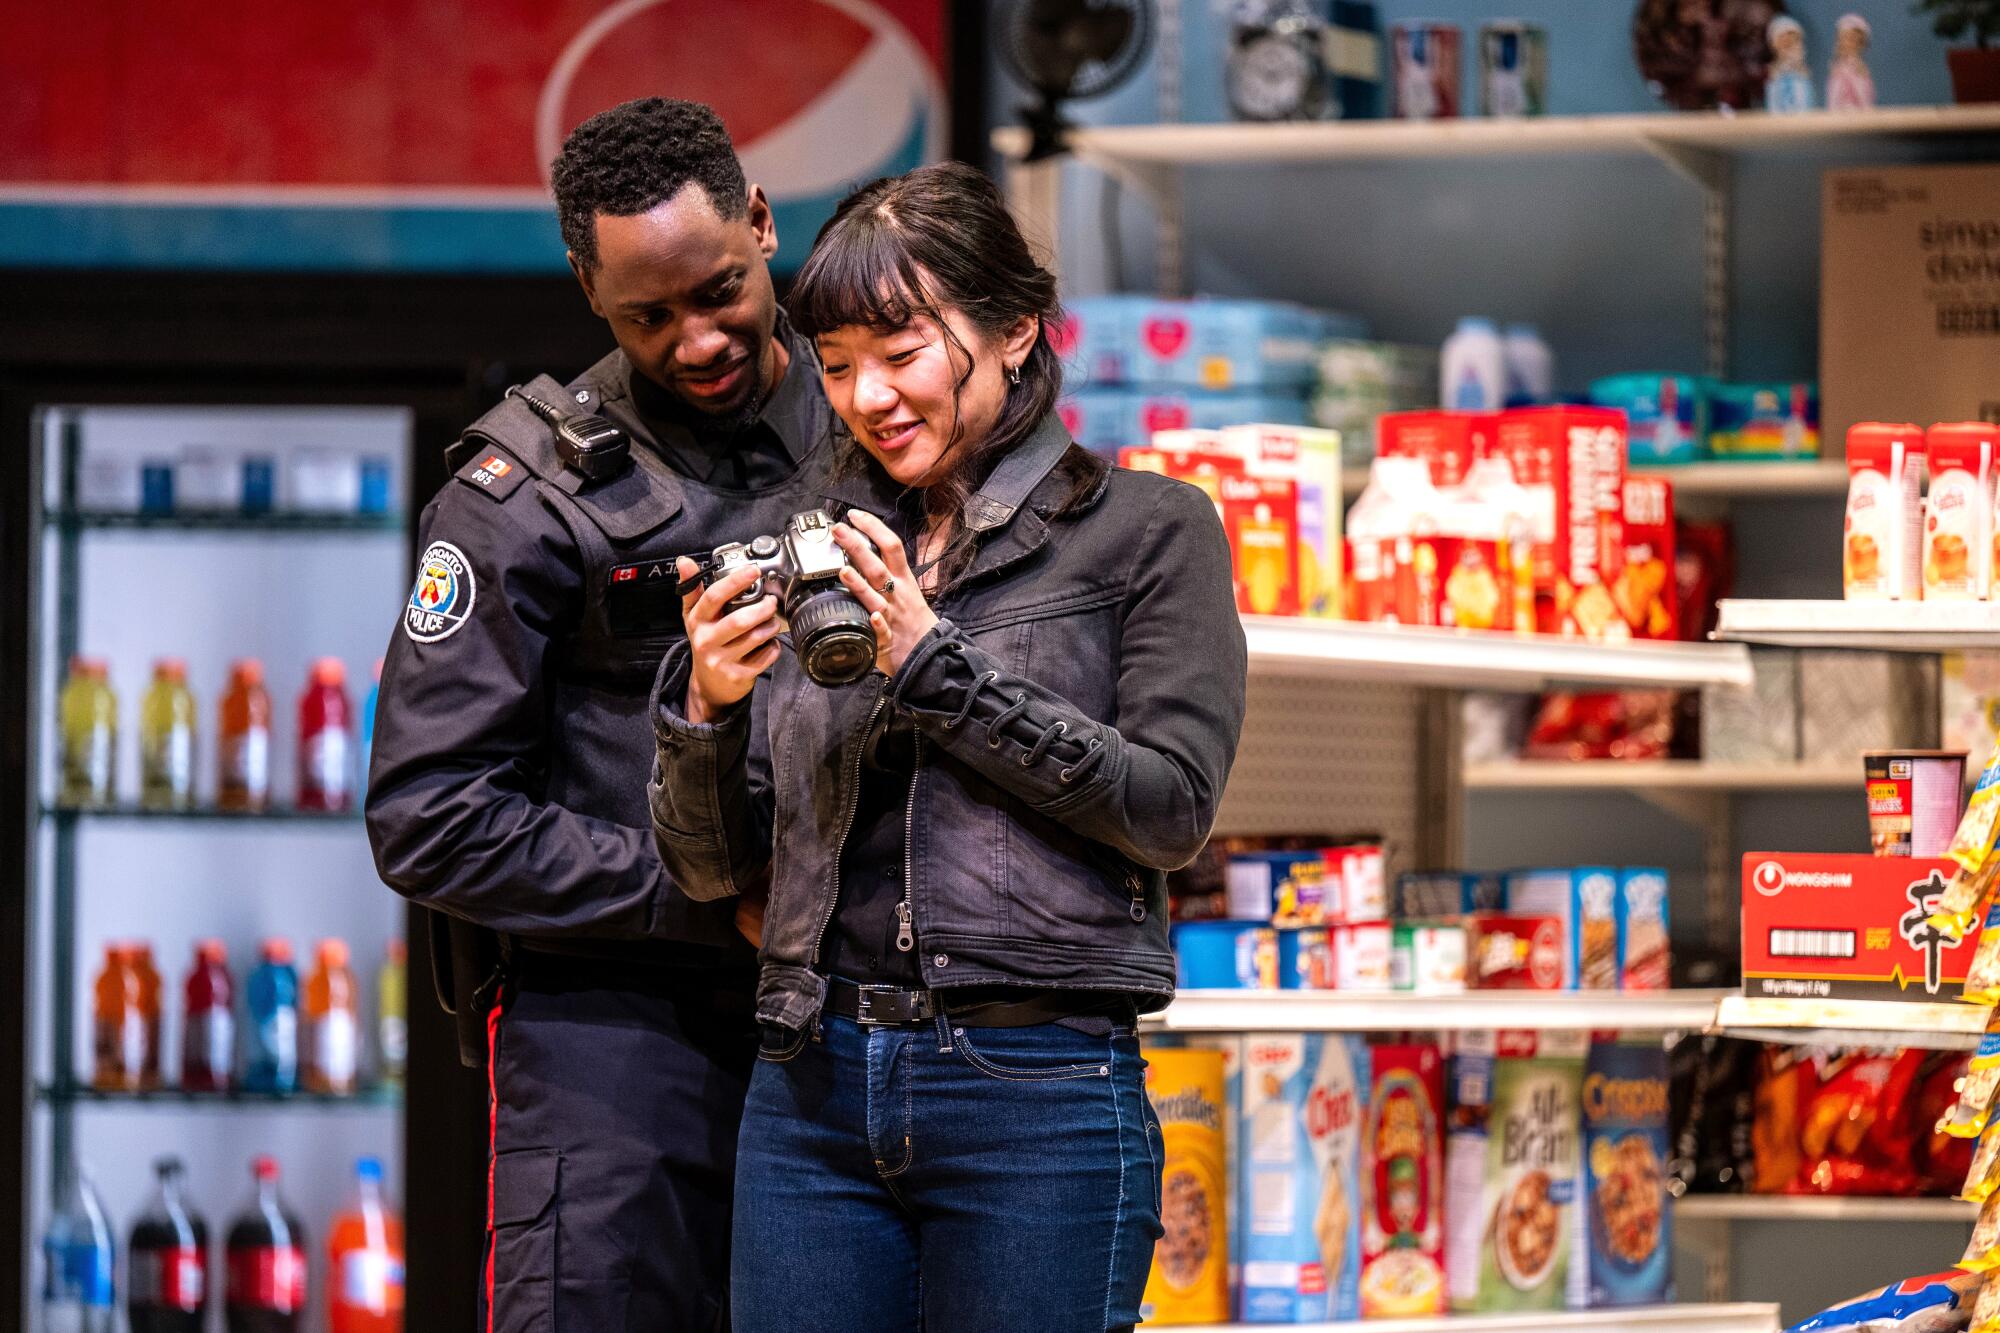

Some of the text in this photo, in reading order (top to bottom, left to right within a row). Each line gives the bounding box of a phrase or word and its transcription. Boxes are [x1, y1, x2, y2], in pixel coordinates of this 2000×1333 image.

[471, 469, 495, 486] 065
[422, 548, 464, 576] TORONTO
[811, 568, 838, 580] Canon
[409, 609, 444, 633] POLICE
[1785, 871, 1852, 888] NONGSHIM
[1502, 1116, 1571, 1167] Bran
